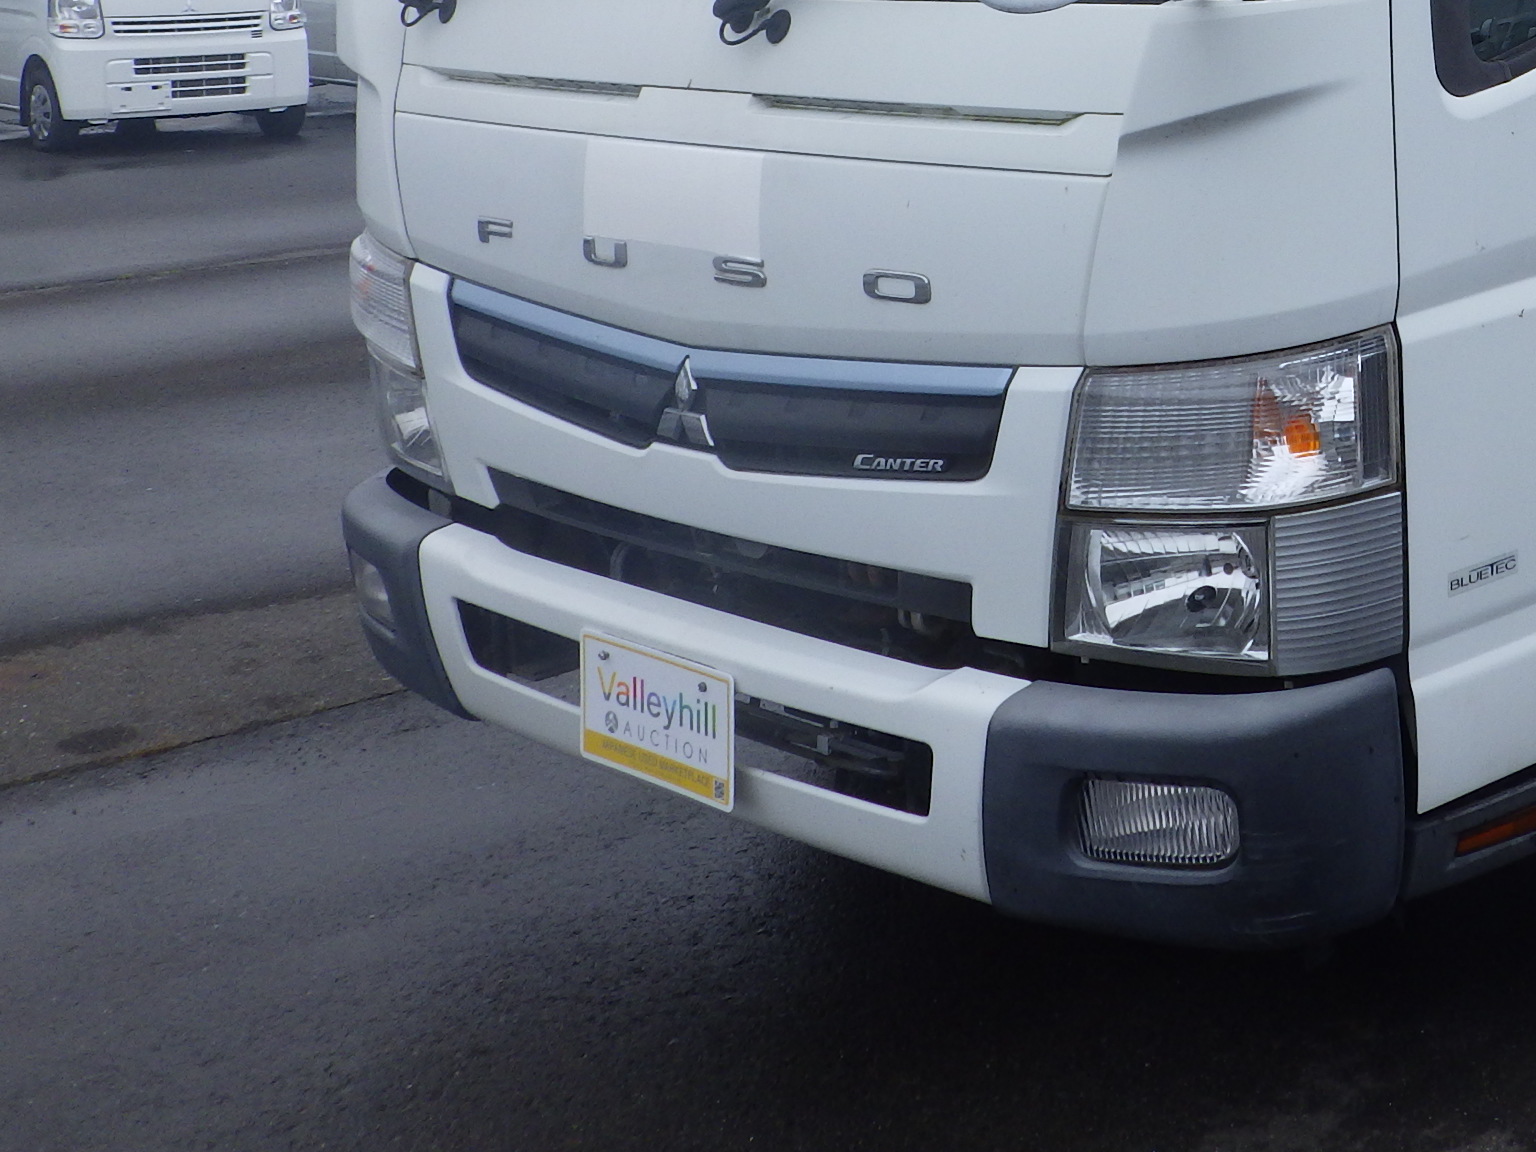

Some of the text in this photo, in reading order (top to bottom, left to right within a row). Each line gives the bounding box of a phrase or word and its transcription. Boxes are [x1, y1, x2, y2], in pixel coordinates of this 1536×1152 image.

[477, 215, 932, 304] FUSO
[597, 666, 716, 739] Valleyhill
[623, 720, 708, 764] AUCTION
